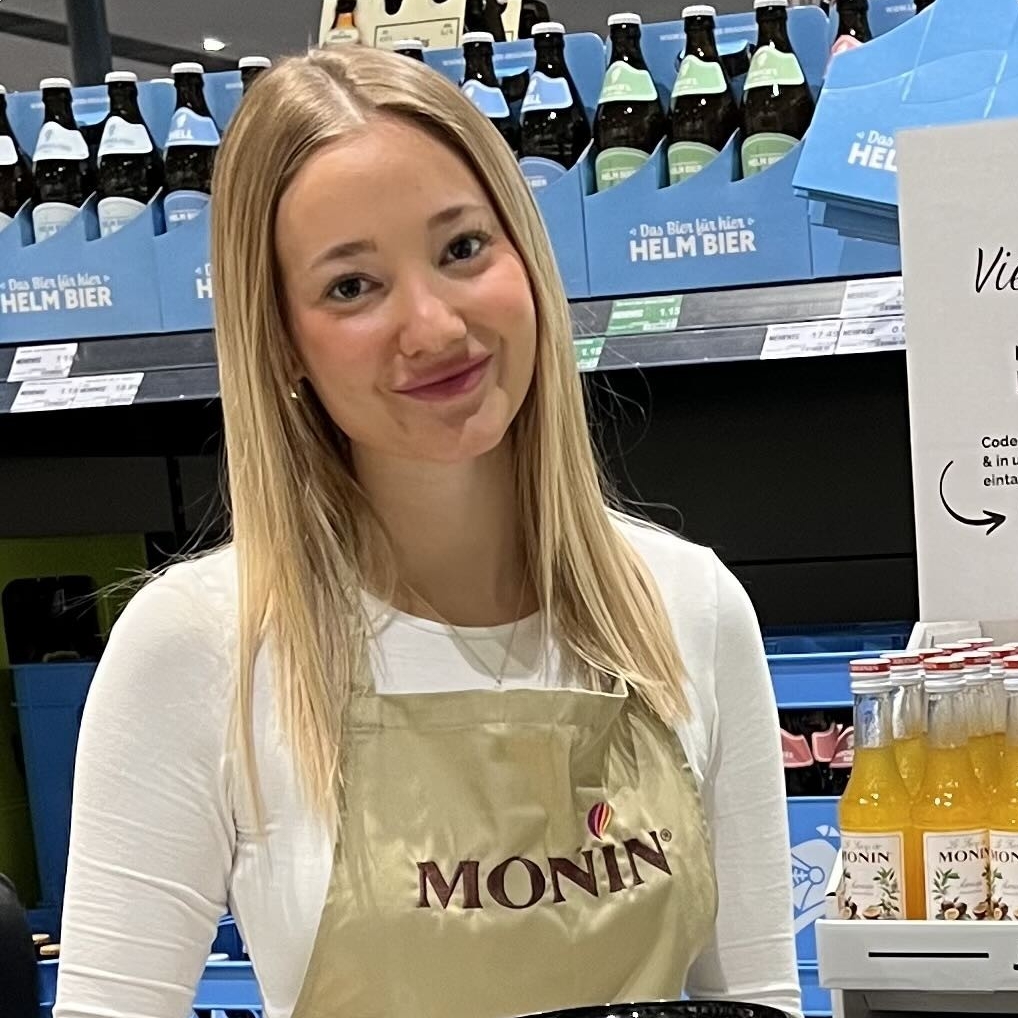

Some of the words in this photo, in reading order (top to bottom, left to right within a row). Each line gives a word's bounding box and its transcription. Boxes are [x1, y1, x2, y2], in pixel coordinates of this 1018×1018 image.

[848, 142, 898, 172] HEL
[640, 223, 664, 238] Das
[666, 220, 694, 235] Bier
[718, 216, 745, 231] hier
[629, 235, 697, 262] HELM
[702, 230, 757, 256] BIER
[0, 290, 61, 314] HELM
[64, 286, 113, 310] BIER
[981, 435, 1018, 449] Code
[982, 456, 993, 468] &
[996, 454, 1009, 467] in
[416, 831, 673, 910] MONIN
